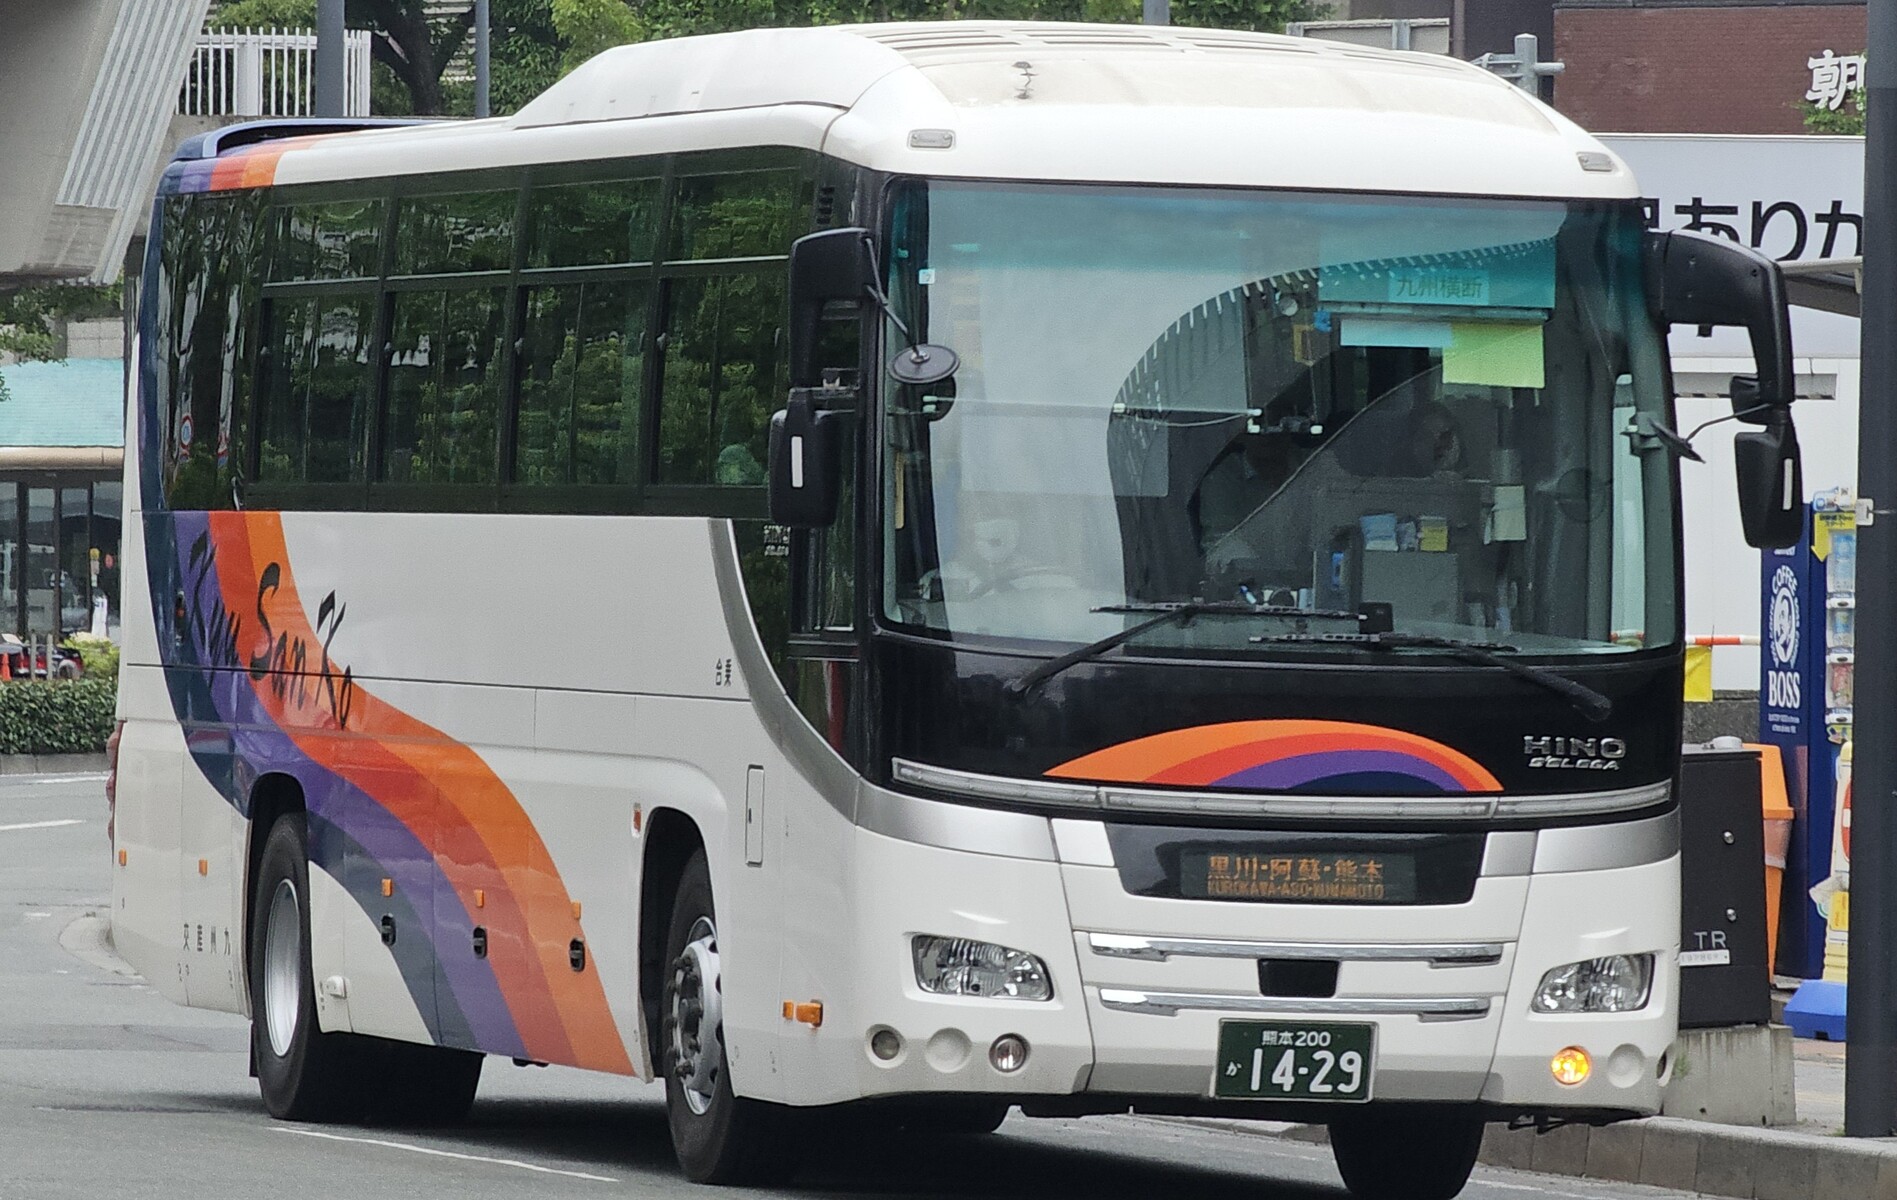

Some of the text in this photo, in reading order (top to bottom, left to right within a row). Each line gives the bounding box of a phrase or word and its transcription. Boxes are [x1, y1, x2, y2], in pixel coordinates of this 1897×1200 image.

[1396, 275, 1483, 299] 九州横断
[1768, 670, 1800, 709] BOSS
[1523, 736, 1626, 758] HINO
